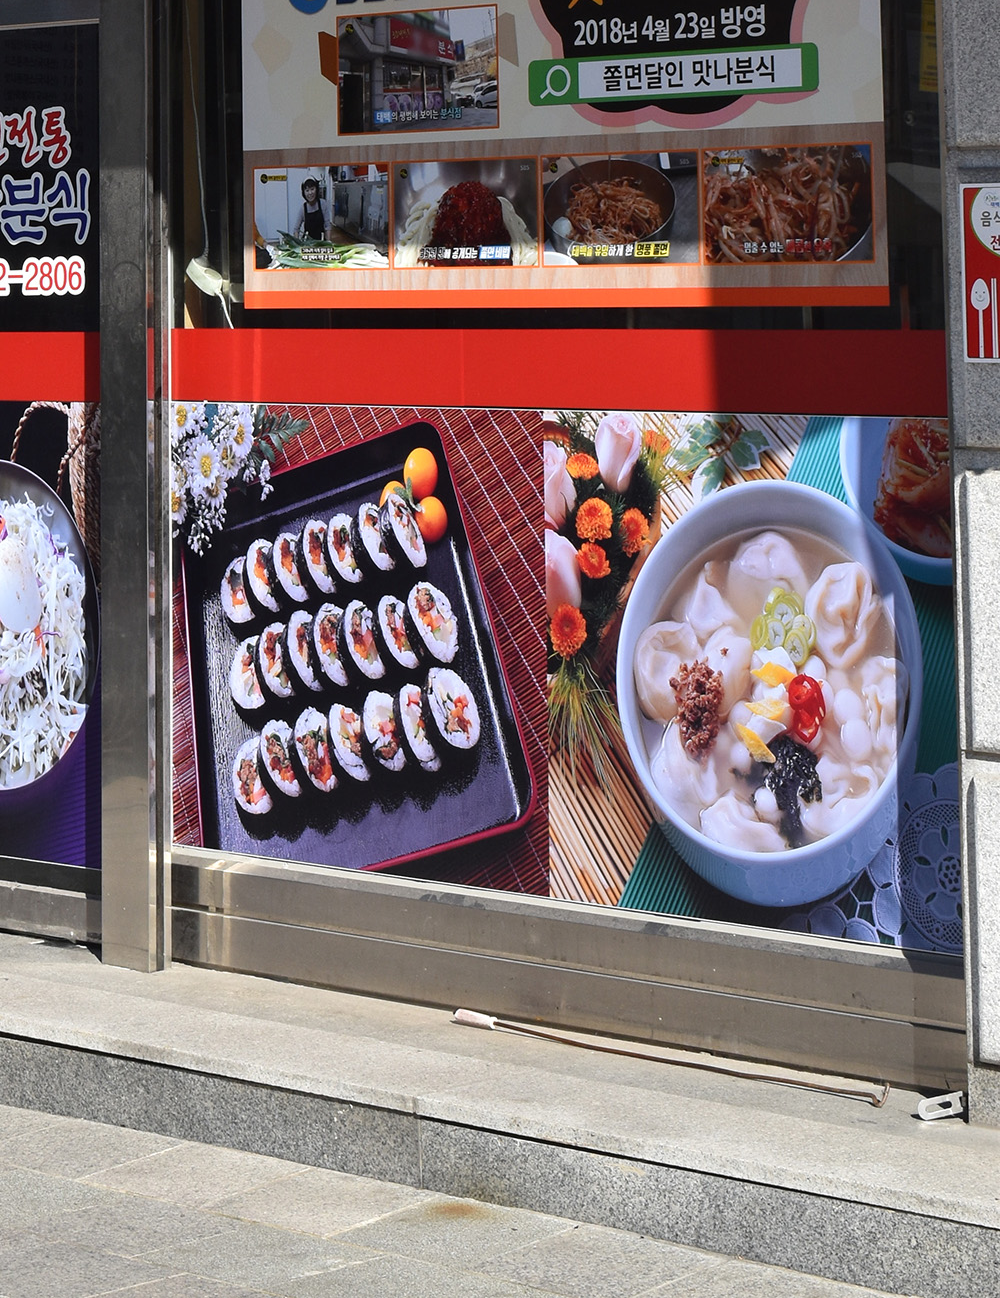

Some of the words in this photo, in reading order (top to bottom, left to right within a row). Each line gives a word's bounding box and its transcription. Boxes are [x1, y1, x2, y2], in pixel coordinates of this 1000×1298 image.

[573, 17, 638, 46] 2018년
[641, 15, 671, 42] 4월
[674, 12, 716, 39] 23일
[720, 4, 767, 39] 방영
[603, 60, 684, 92] 쫄면달인
[692, 55, 776, 87] 맛나분식
[440, 107, 462, 120] 분식점
[636, 243, 651, 256] 명품
[760, 241, 768, 253] 수
